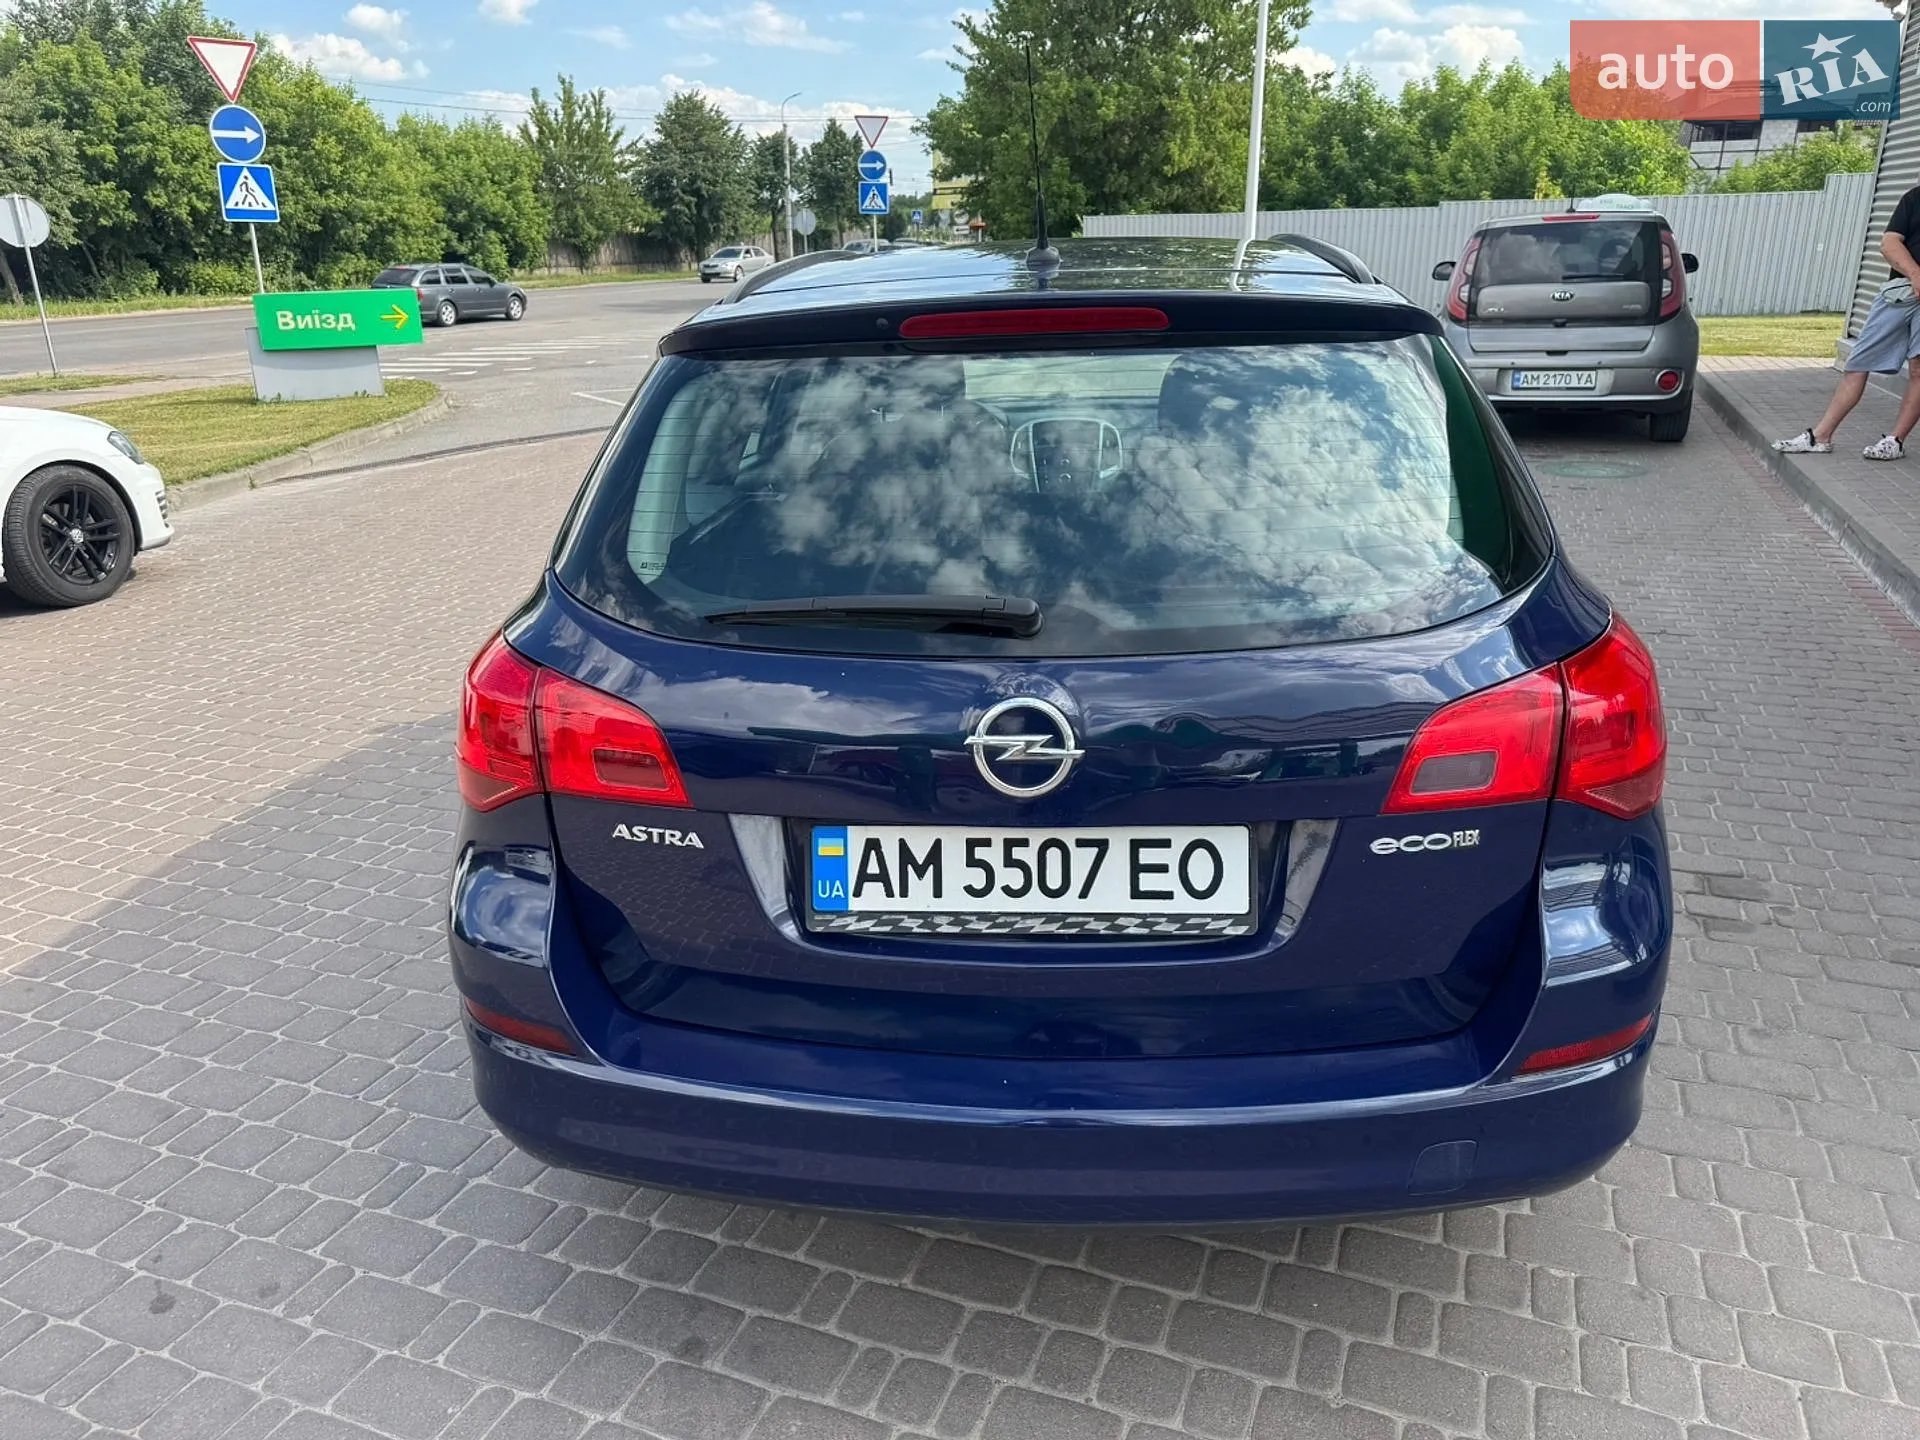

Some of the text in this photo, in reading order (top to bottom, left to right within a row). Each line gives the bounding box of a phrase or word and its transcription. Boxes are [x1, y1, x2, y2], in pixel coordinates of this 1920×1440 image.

[276, 310, 356, 332] Виїзд
[1521, 373, 1593, 385] AM 2170 YA
[612, 823, 705, 850] ASTRA
[852, 837, 1223, 900] AM 5507 EO
[818, 880, 845, 898] UA
